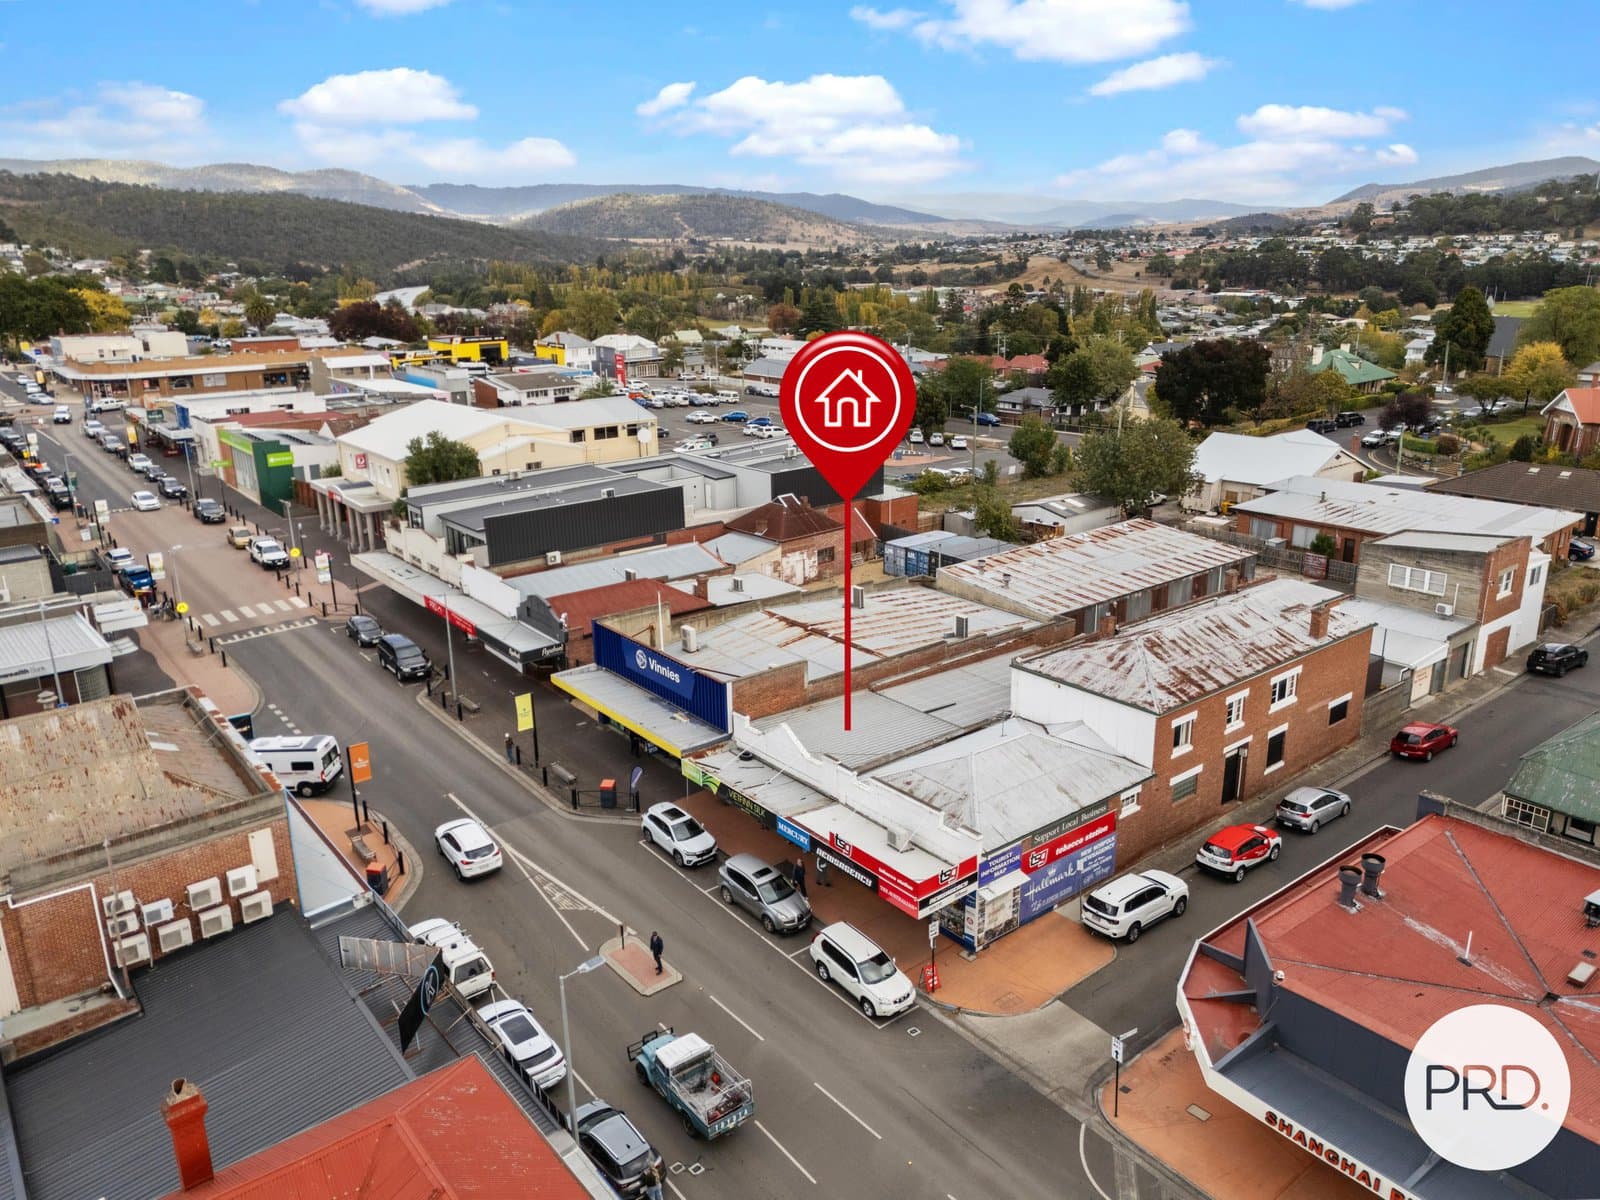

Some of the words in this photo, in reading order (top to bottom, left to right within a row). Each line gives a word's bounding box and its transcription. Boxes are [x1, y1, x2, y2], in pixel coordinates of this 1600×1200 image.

[648, 657, 680, 683] Vinnies
[777, 821, 809, 845] MERCURY
[1034, 825, 1060, 845] Support
[1062, 815, 1079, 831] Local
[1081, 805, 1107, 821] Business
[1056, 837, 1084, 856] tobacco
[1085, 825, 1109, 842] station
[980, 854, 1020, 878] INFORMATION
[988, 851, 1013, 867] TOURIST
[994, 867, 1007, 877] MAP
[1024, 862, 1078, 901] Hallmark
[1264, 1110, 1381, 1193] SHANGHAI
